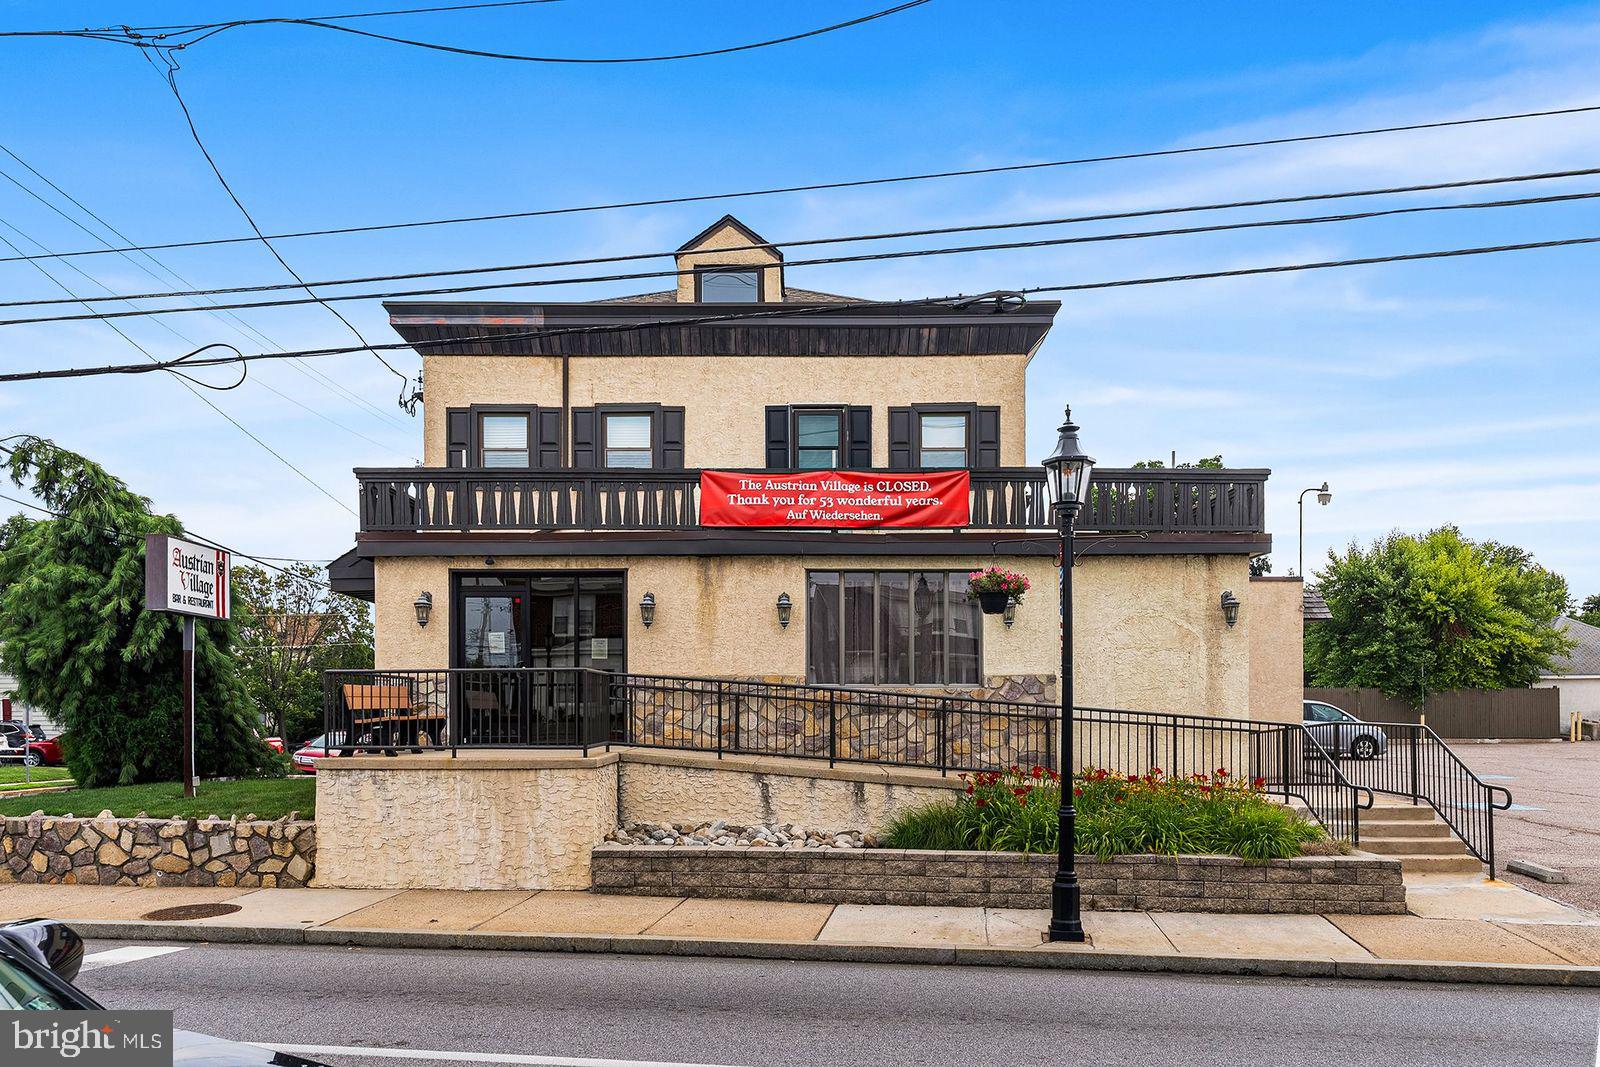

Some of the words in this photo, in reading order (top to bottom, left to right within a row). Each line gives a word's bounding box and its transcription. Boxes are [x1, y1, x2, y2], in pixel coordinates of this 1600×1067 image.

[739, 480, 761, 490] The
[765, 480, 817, 490] Austrian
[820, 481, 860, 494] Village
[864, 482, 874, 491] is
[876, 482, 932, 491] CLOSED.
[727, 494, 770, 504] Thank
[773, 497, 795, 507] you
[798, 495, 816, 505] for
[820, 496, 834, 507] 53
[838, 496, 902, 506] wonderful
[905, 497, 942, 508] years.
[787, 510, 808, 519] Auf
[810, 510, 884, 520] Wiedersehen.
[173, 548, 214, 575] Austrian
[180, 570, 214, 598] Village
[172, 594, 181, 603] BAR
[183, 596, 186, 604] &
[188, 597, 214, 609] RESTAURANT
